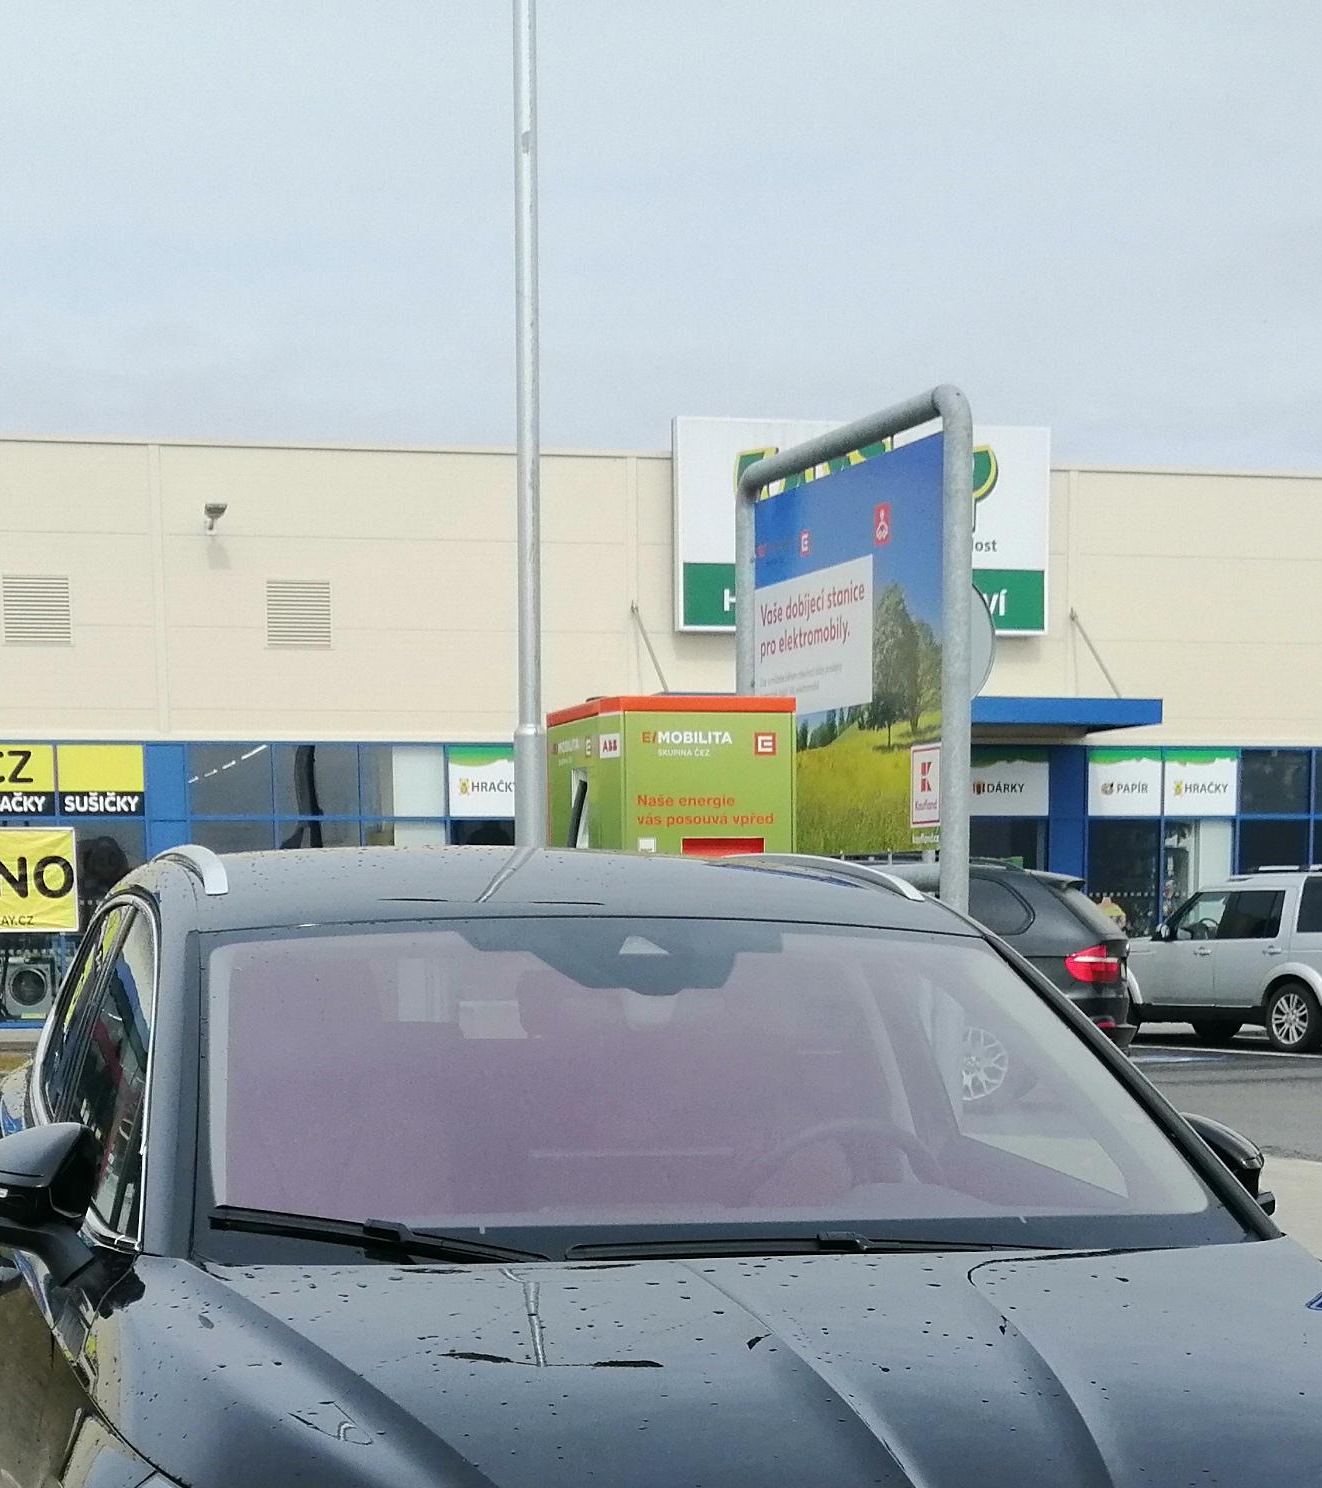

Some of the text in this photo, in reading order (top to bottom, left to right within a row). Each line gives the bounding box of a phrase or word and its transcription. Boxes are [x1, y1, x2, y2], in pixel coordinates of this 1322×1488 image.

[760, 601, 783, 627] Vaše
[786, 588, 825, 621] dobíjecí
[827, 580, 865, 610] stanice
[760, 615, 851, 663] pro elektromobily.
[602, 739, 618, 753] ABB
[471, 780, 515, 793] HRAČK
[986, 781, 1025, 794] DÁRKY
[1116, 781, 1149, 794] PAPÍR
[1184, 781, 1228, 794] HRAČKY
[64, 792, 139, 813] SUŠIČKY
[637, 795, 736, 809] Naše energie
[637, 813, 775, 828] vás posouvá vpřed
